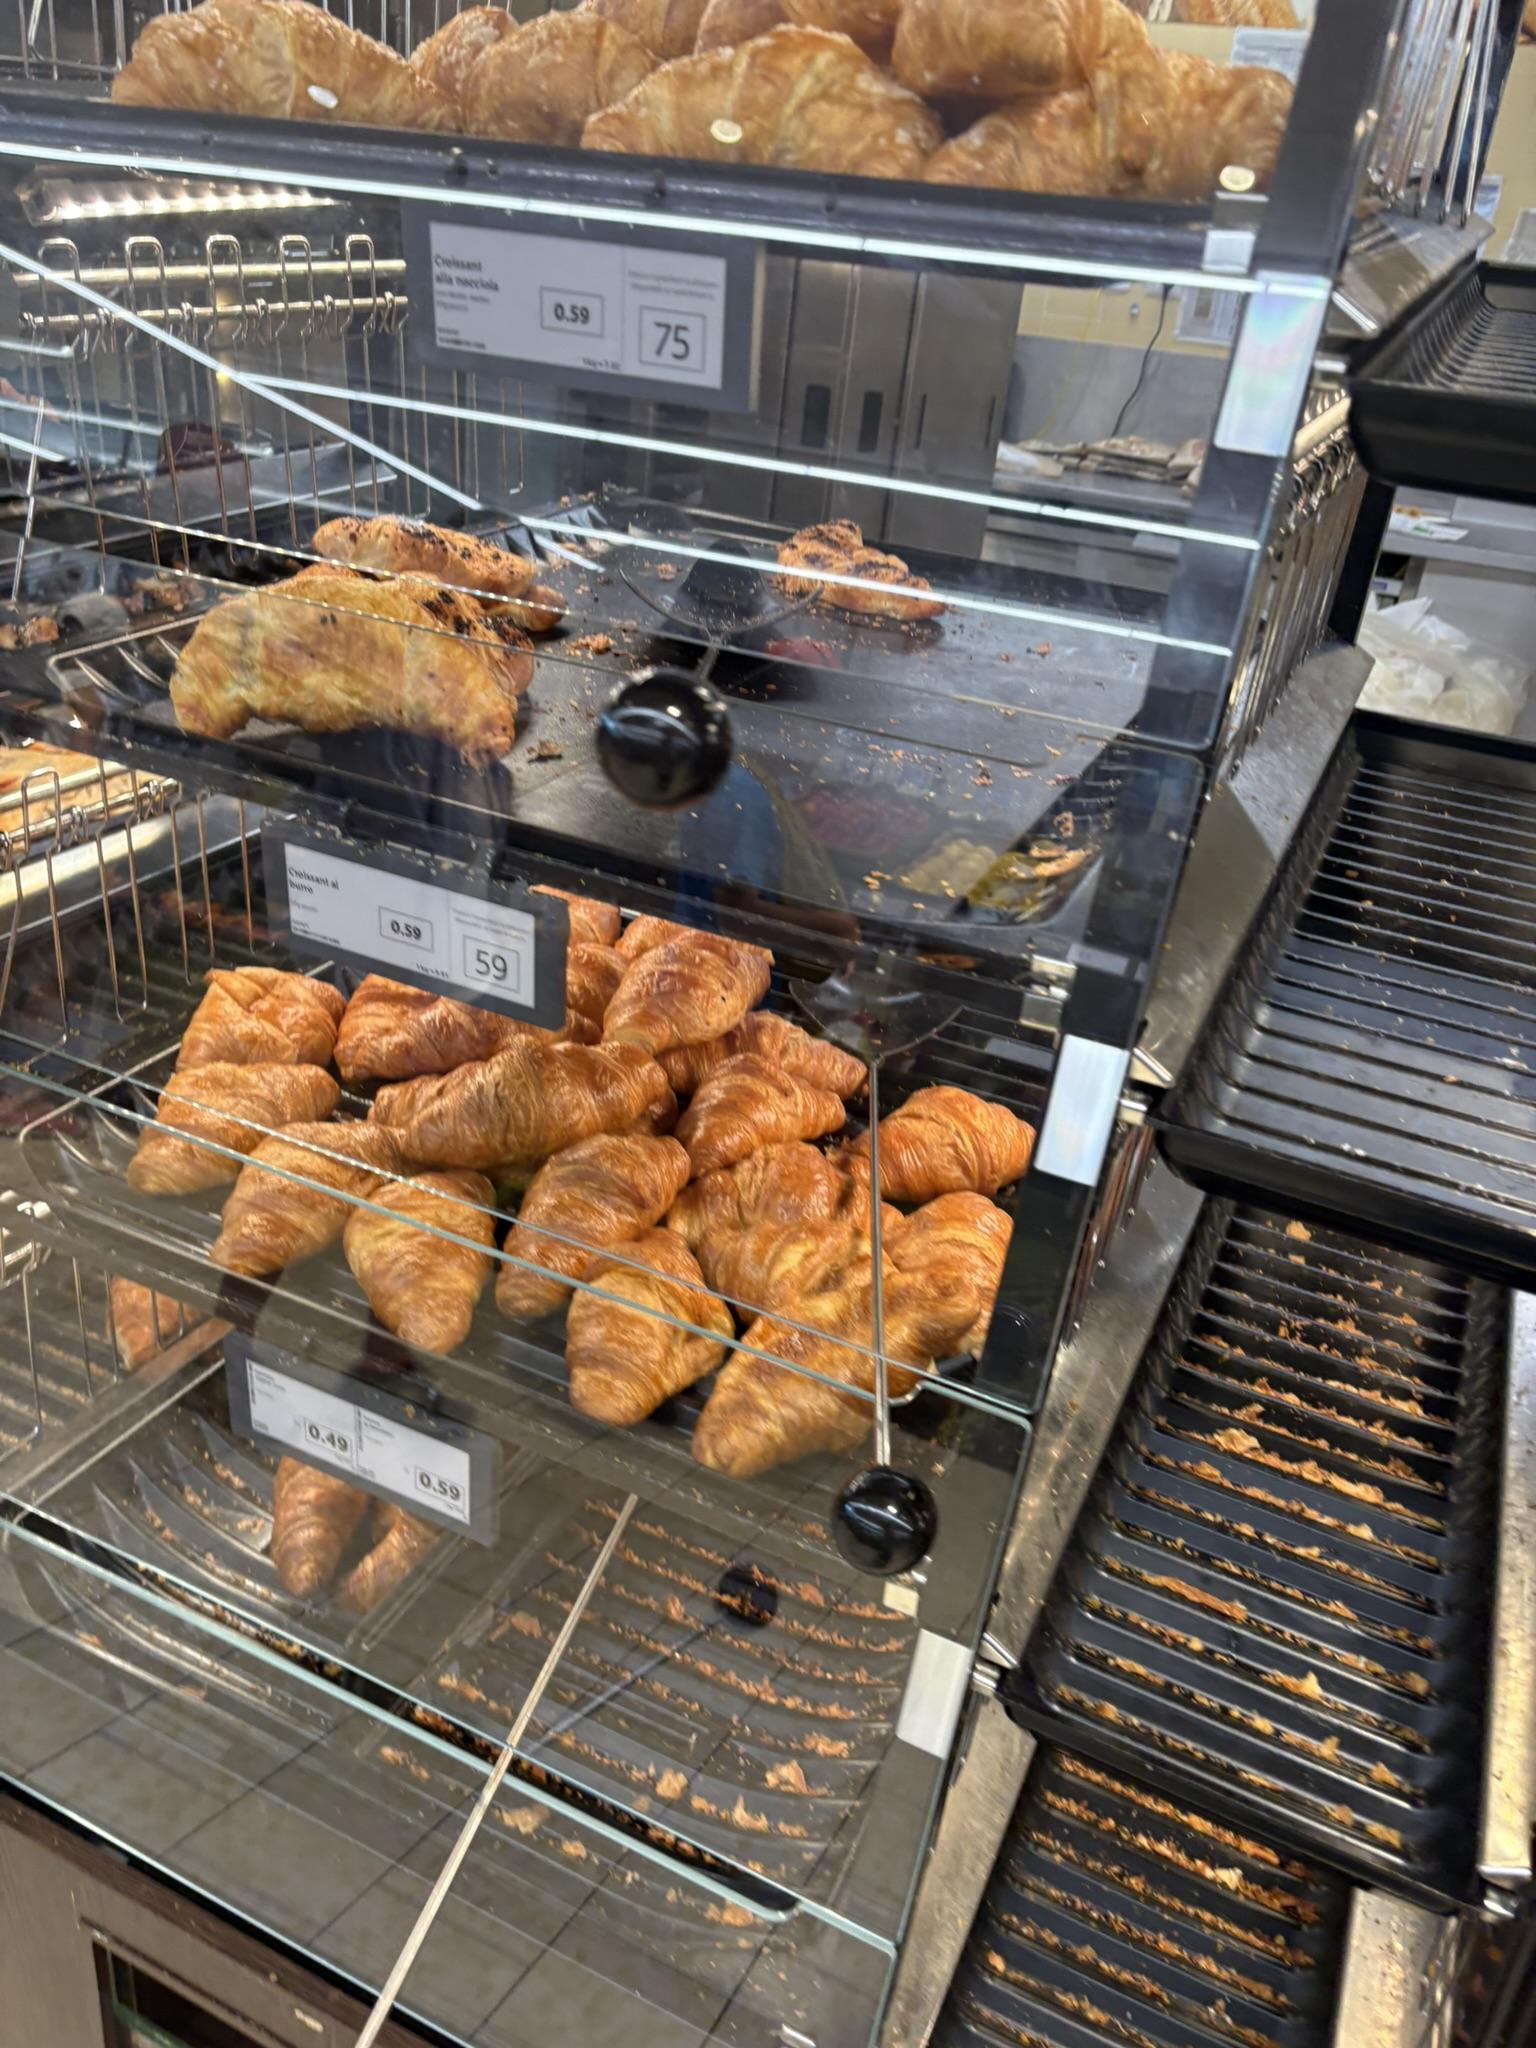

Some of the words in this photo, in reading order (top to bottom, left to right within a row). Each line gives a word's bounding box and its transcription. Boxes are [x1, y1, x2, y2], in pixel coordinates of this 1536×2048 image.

[434, 254, 482, 272] Croissant
[435, 272, 453, 285] alla
[554, 302, 590, 324] 0.59
[654, 321, 690, 361] 75
[288, 867, 329, 888] Croissant
[391, 919, 421, 940] 0.59
[475, 948, 507, 980] 59
[308, 1424, 348, 1452] 0.49
[420, 1471, 460, 1500] 0.59
